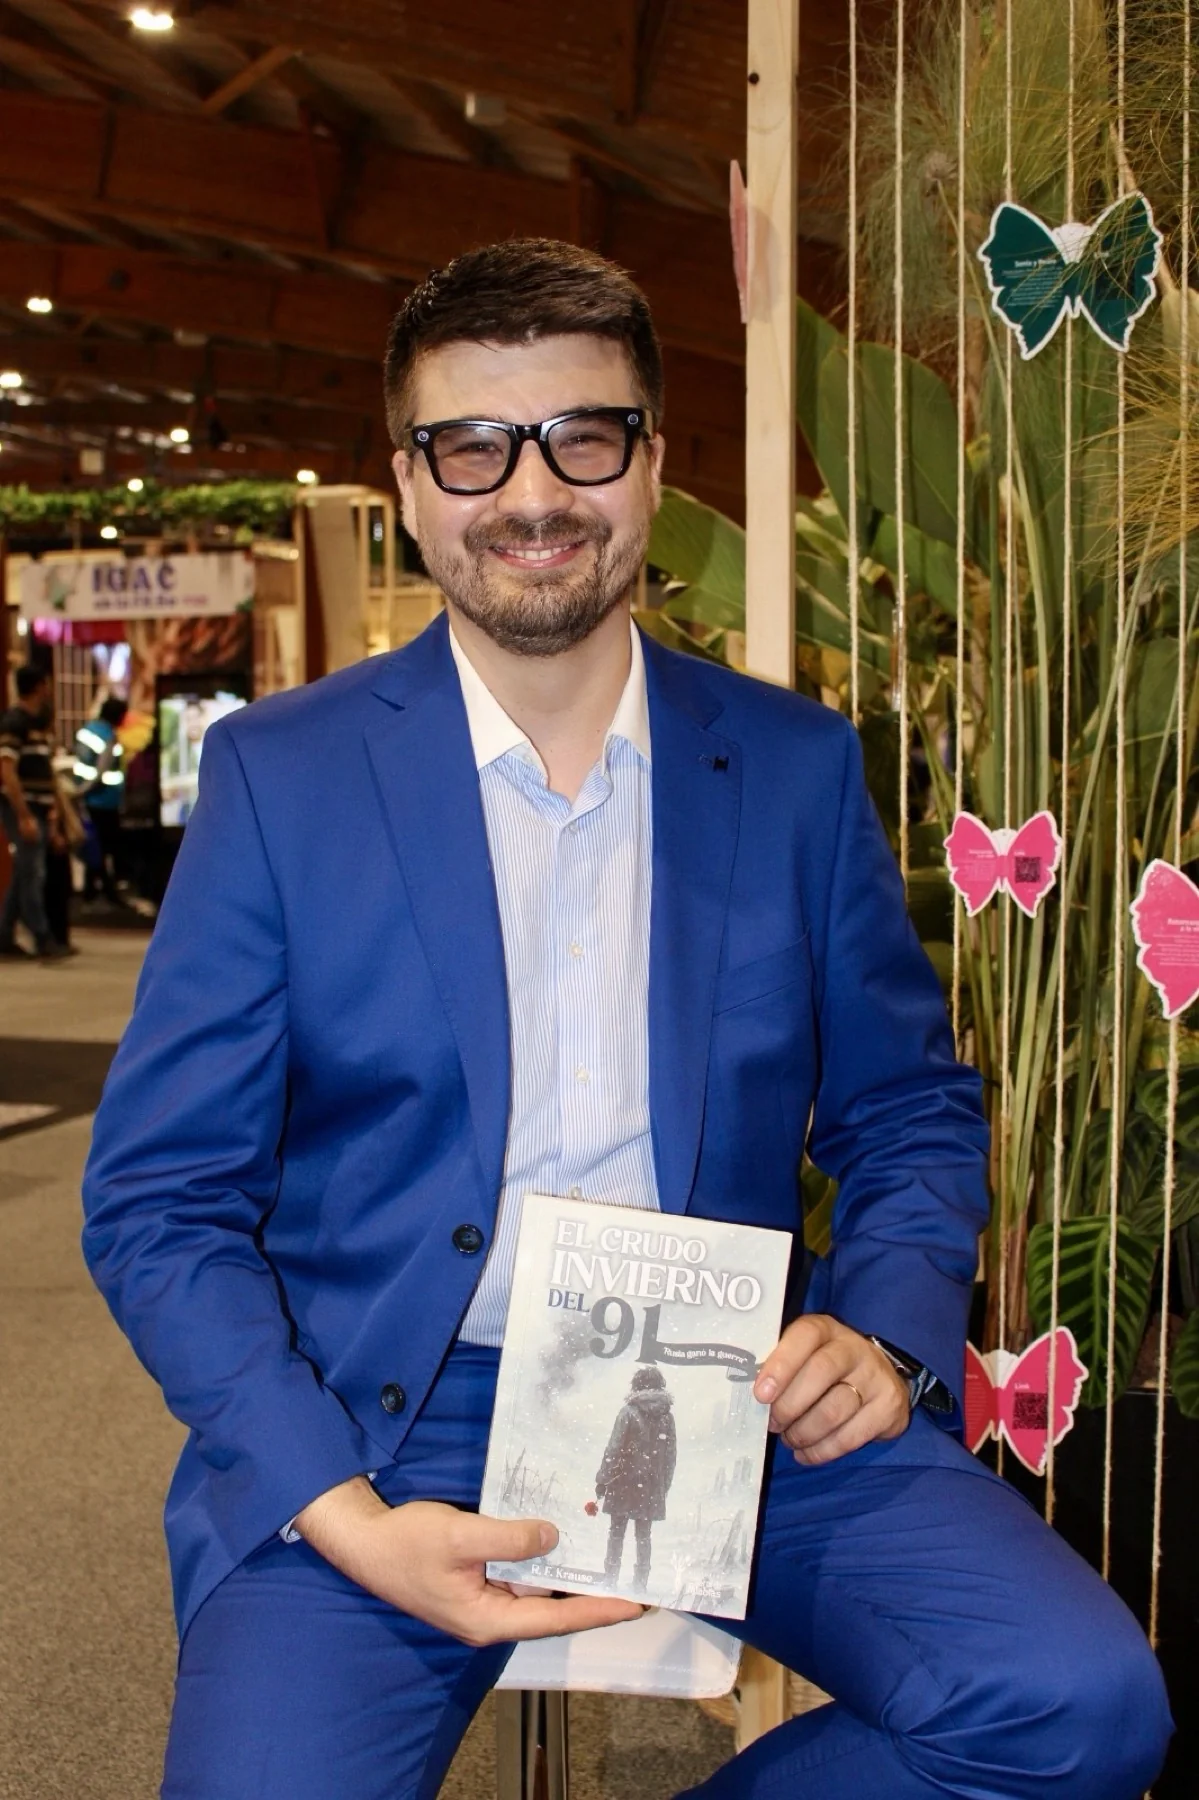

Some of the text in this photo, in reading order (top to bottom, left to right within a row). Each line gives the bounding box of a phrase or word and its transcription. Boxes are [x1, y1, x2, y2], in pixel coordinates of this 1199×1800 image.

[556, 1220, 707, 1264] EL CRUDO
[549, 1249, 762, 1311] INVIERNO
[547, 1288, 662, 1365] DEL 91
[531, 1564, 542, 1575] R.
